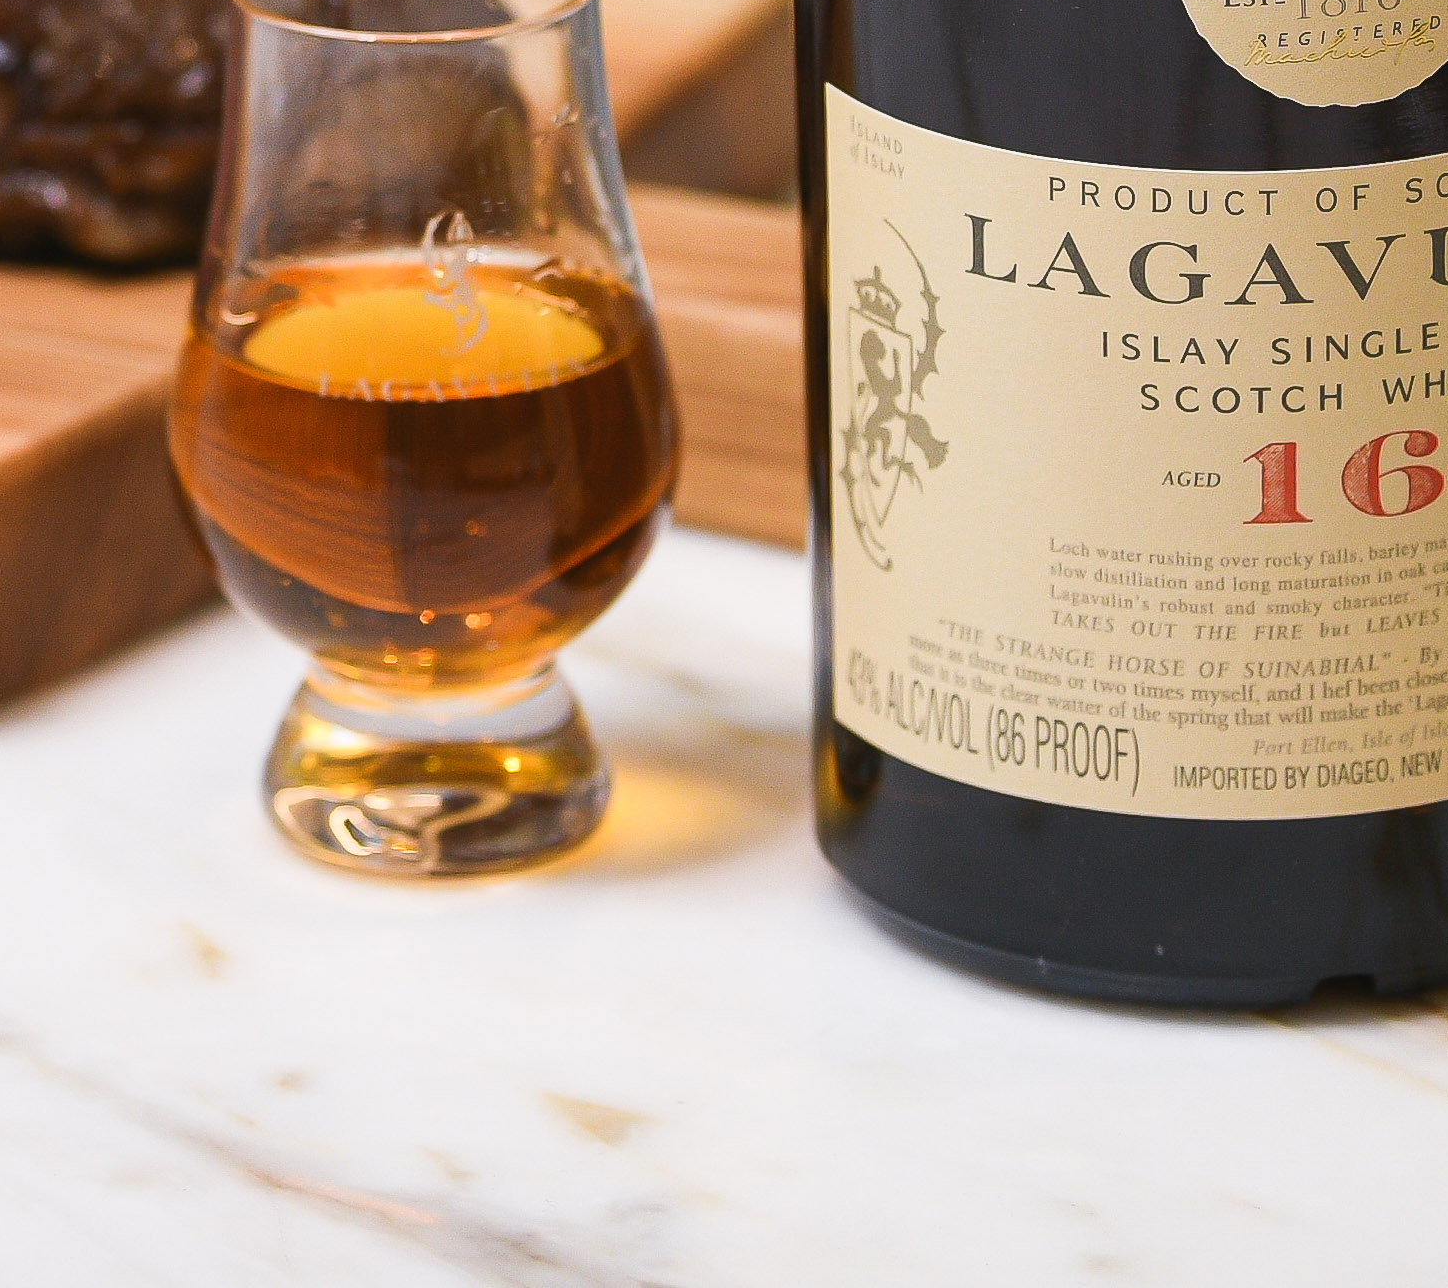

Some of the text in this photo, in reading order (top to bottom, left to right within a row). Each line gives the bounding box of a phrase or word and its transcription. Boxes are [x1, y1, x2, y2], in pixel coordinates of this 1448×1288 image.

[1257, 15, 1442, 48] REGISTERED
[1049, 176, 1279, 216] PRODUCT
[1316, 183, 1371, 213] OF
[1102, 330, 1240, 366] ISLAY
[1270, 321, 1441, 365] SINGLE
[1141, 382, 1345, 415] SCOTCH
[1161, 470, 1223, 489] AGED
[1241, 429, 1446, 526] 16
[1049, 537, 1090, 558] Loch
[1096, 547, 1143, 563] water
[1149, 551, 1214, 571] rushing
[1220, 556, 1259, 568] over
[1265, 552, 1314, 571] rocky
[1369, 541, 1420, 561] barley
[1050, 562, 1088, 579] slow
[1195, 576, 1225, 592] and
[1233, 576, 1271, 595] long
[1278, 571, 1371, 592] maturation
[1377, 568, 1392, 583] in
[1398, 563, 1426, 581] oak
[1050, 584, 1150, 612] Lagavulin's
[1159, 598, 1214, 616] robust
[1224, 601, 1255, 616] and
[1266, 598, 1323, 617] smoky
[1051, 609, 1116, 634] TAKES
[1130, 620, 1178, 639] OUT
[1194, 624, 1237, 641] THE
[1253, 624, 1304, 641] FIRE
[1319, 622, 1351, 638] but
[1366, 606, 1441, 634] LEAVES
[995, 634, 1095, 669] STRANGE
[1108, 653, 1185, 677] HORSE
[1199, 660, 1230, 679] OF
[1068, 677, 1086, 691] or
[1093, 679, 1127, 695] two
[1134, 682, 1185, 700] times
[1267, 683, 1301, 702] and
[1357, 678, 1401, 696] been
[1109, 700, 1128, 718] of
[1133, 703, 1162, 722] the
[1168, 709, 1229, 731] spring
[1235, 706, 1270, 726] that
[1279, 705, 1314, 725] will
[1376, 697, 1404, 717] the
[986, 702, 1028, 772] (86
[1035, 715, 1141, 798] PROOF)
[1254, 737, 1293, 756] Port
[1174, 765, 1278, 791] IMPORTED
[1285, 765, 1311, 790] BY
[1401, 747, 1444, 778] NEW
